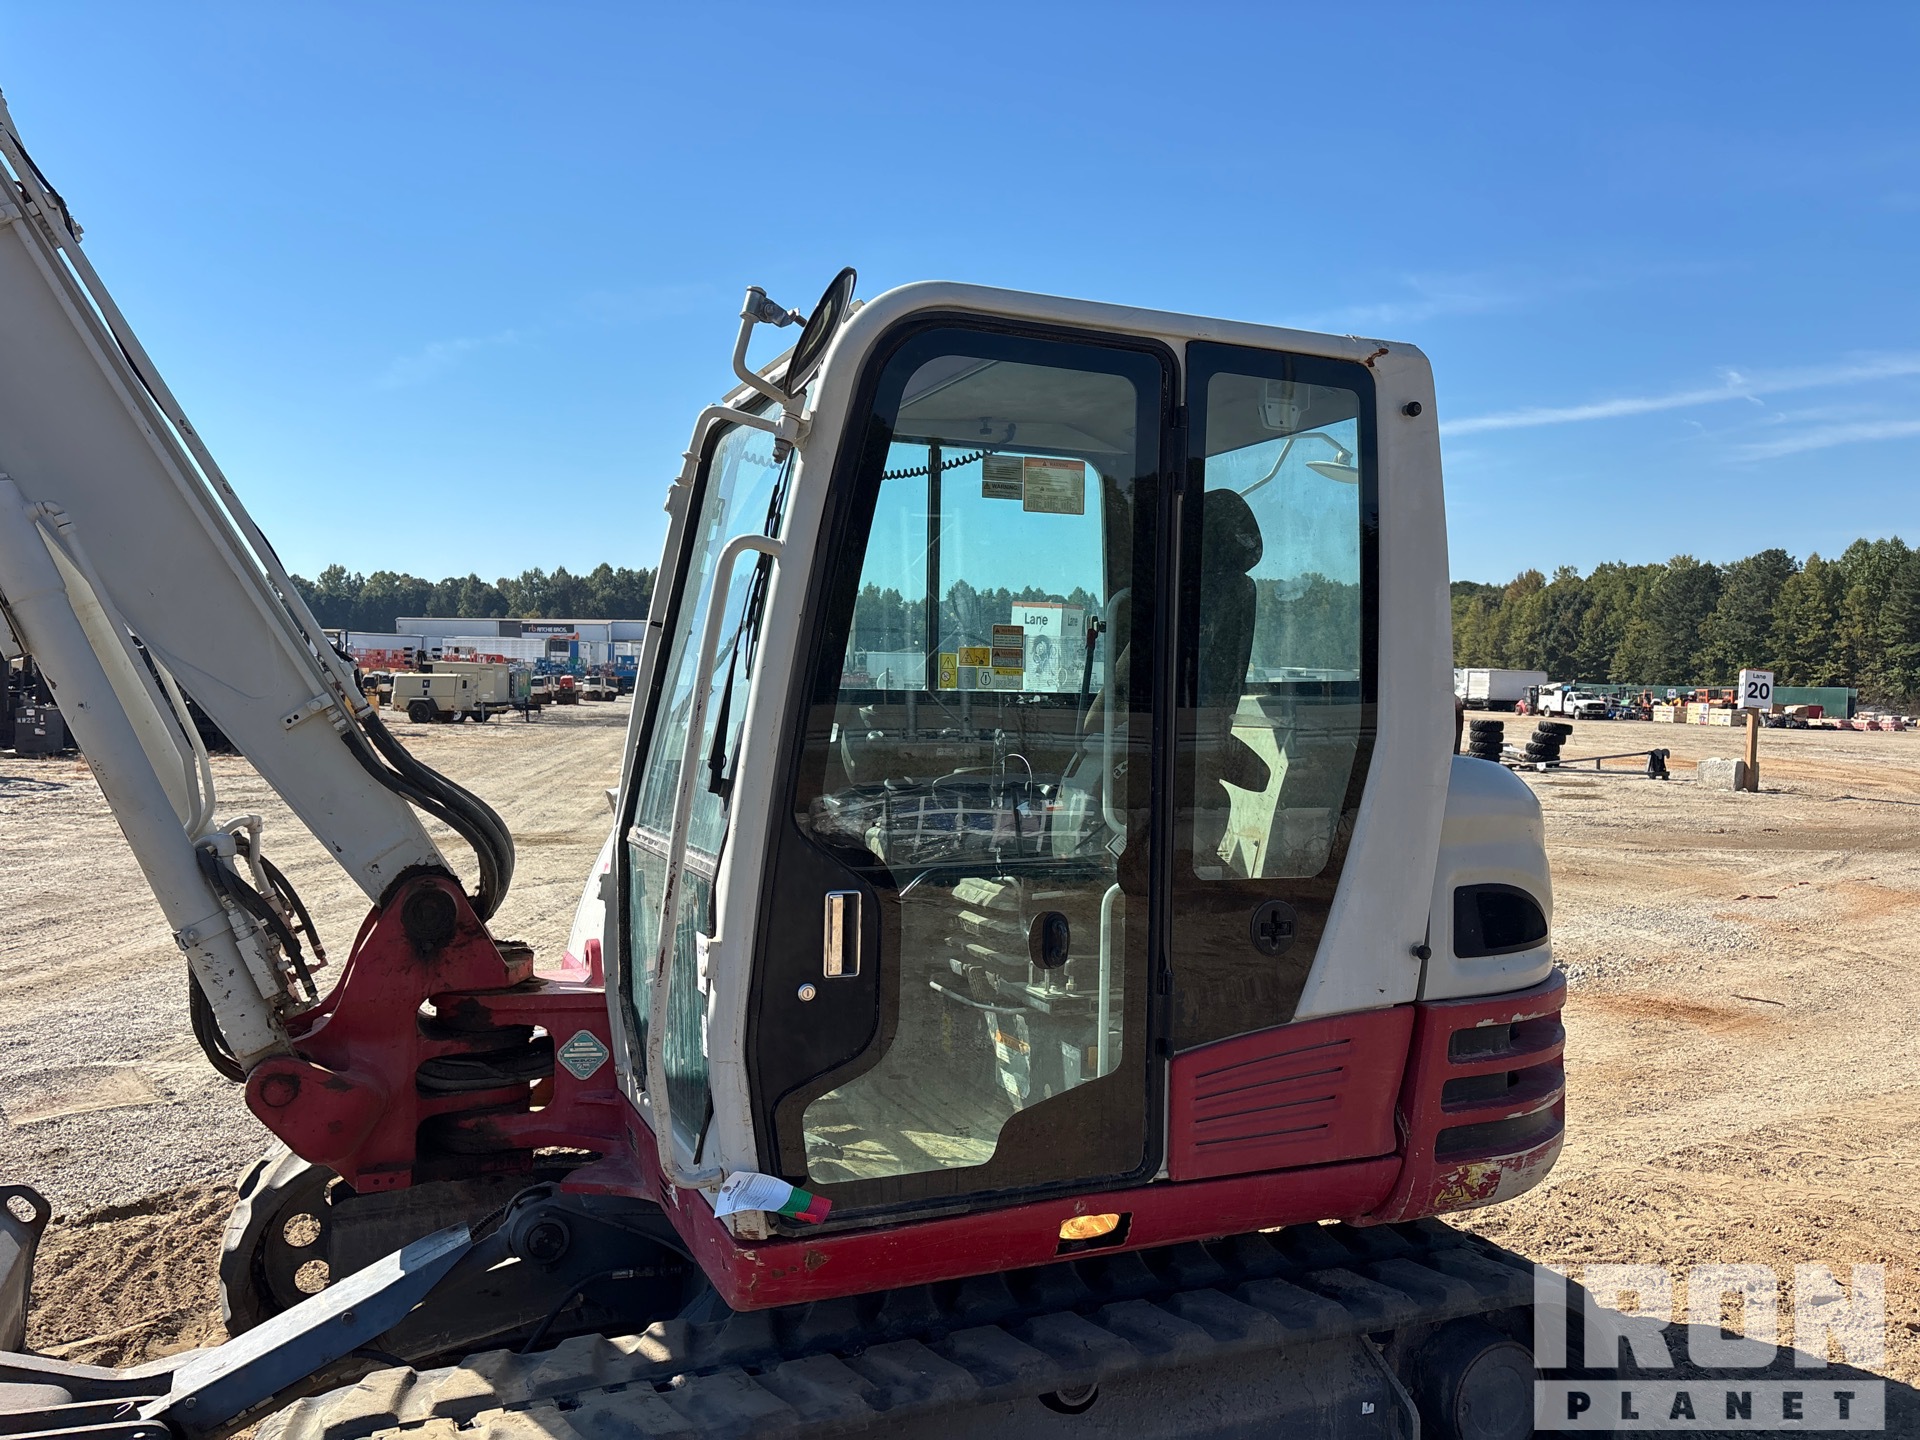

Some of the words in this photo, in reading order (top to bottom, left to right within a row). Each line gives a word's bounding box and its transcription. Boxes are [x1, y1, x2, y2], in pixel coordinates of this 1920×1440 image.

[1024, 613, 1048, 626] Lane
[1067, 614, 1078, 626] Lane
[1747, 682, 1770, 700] 20
